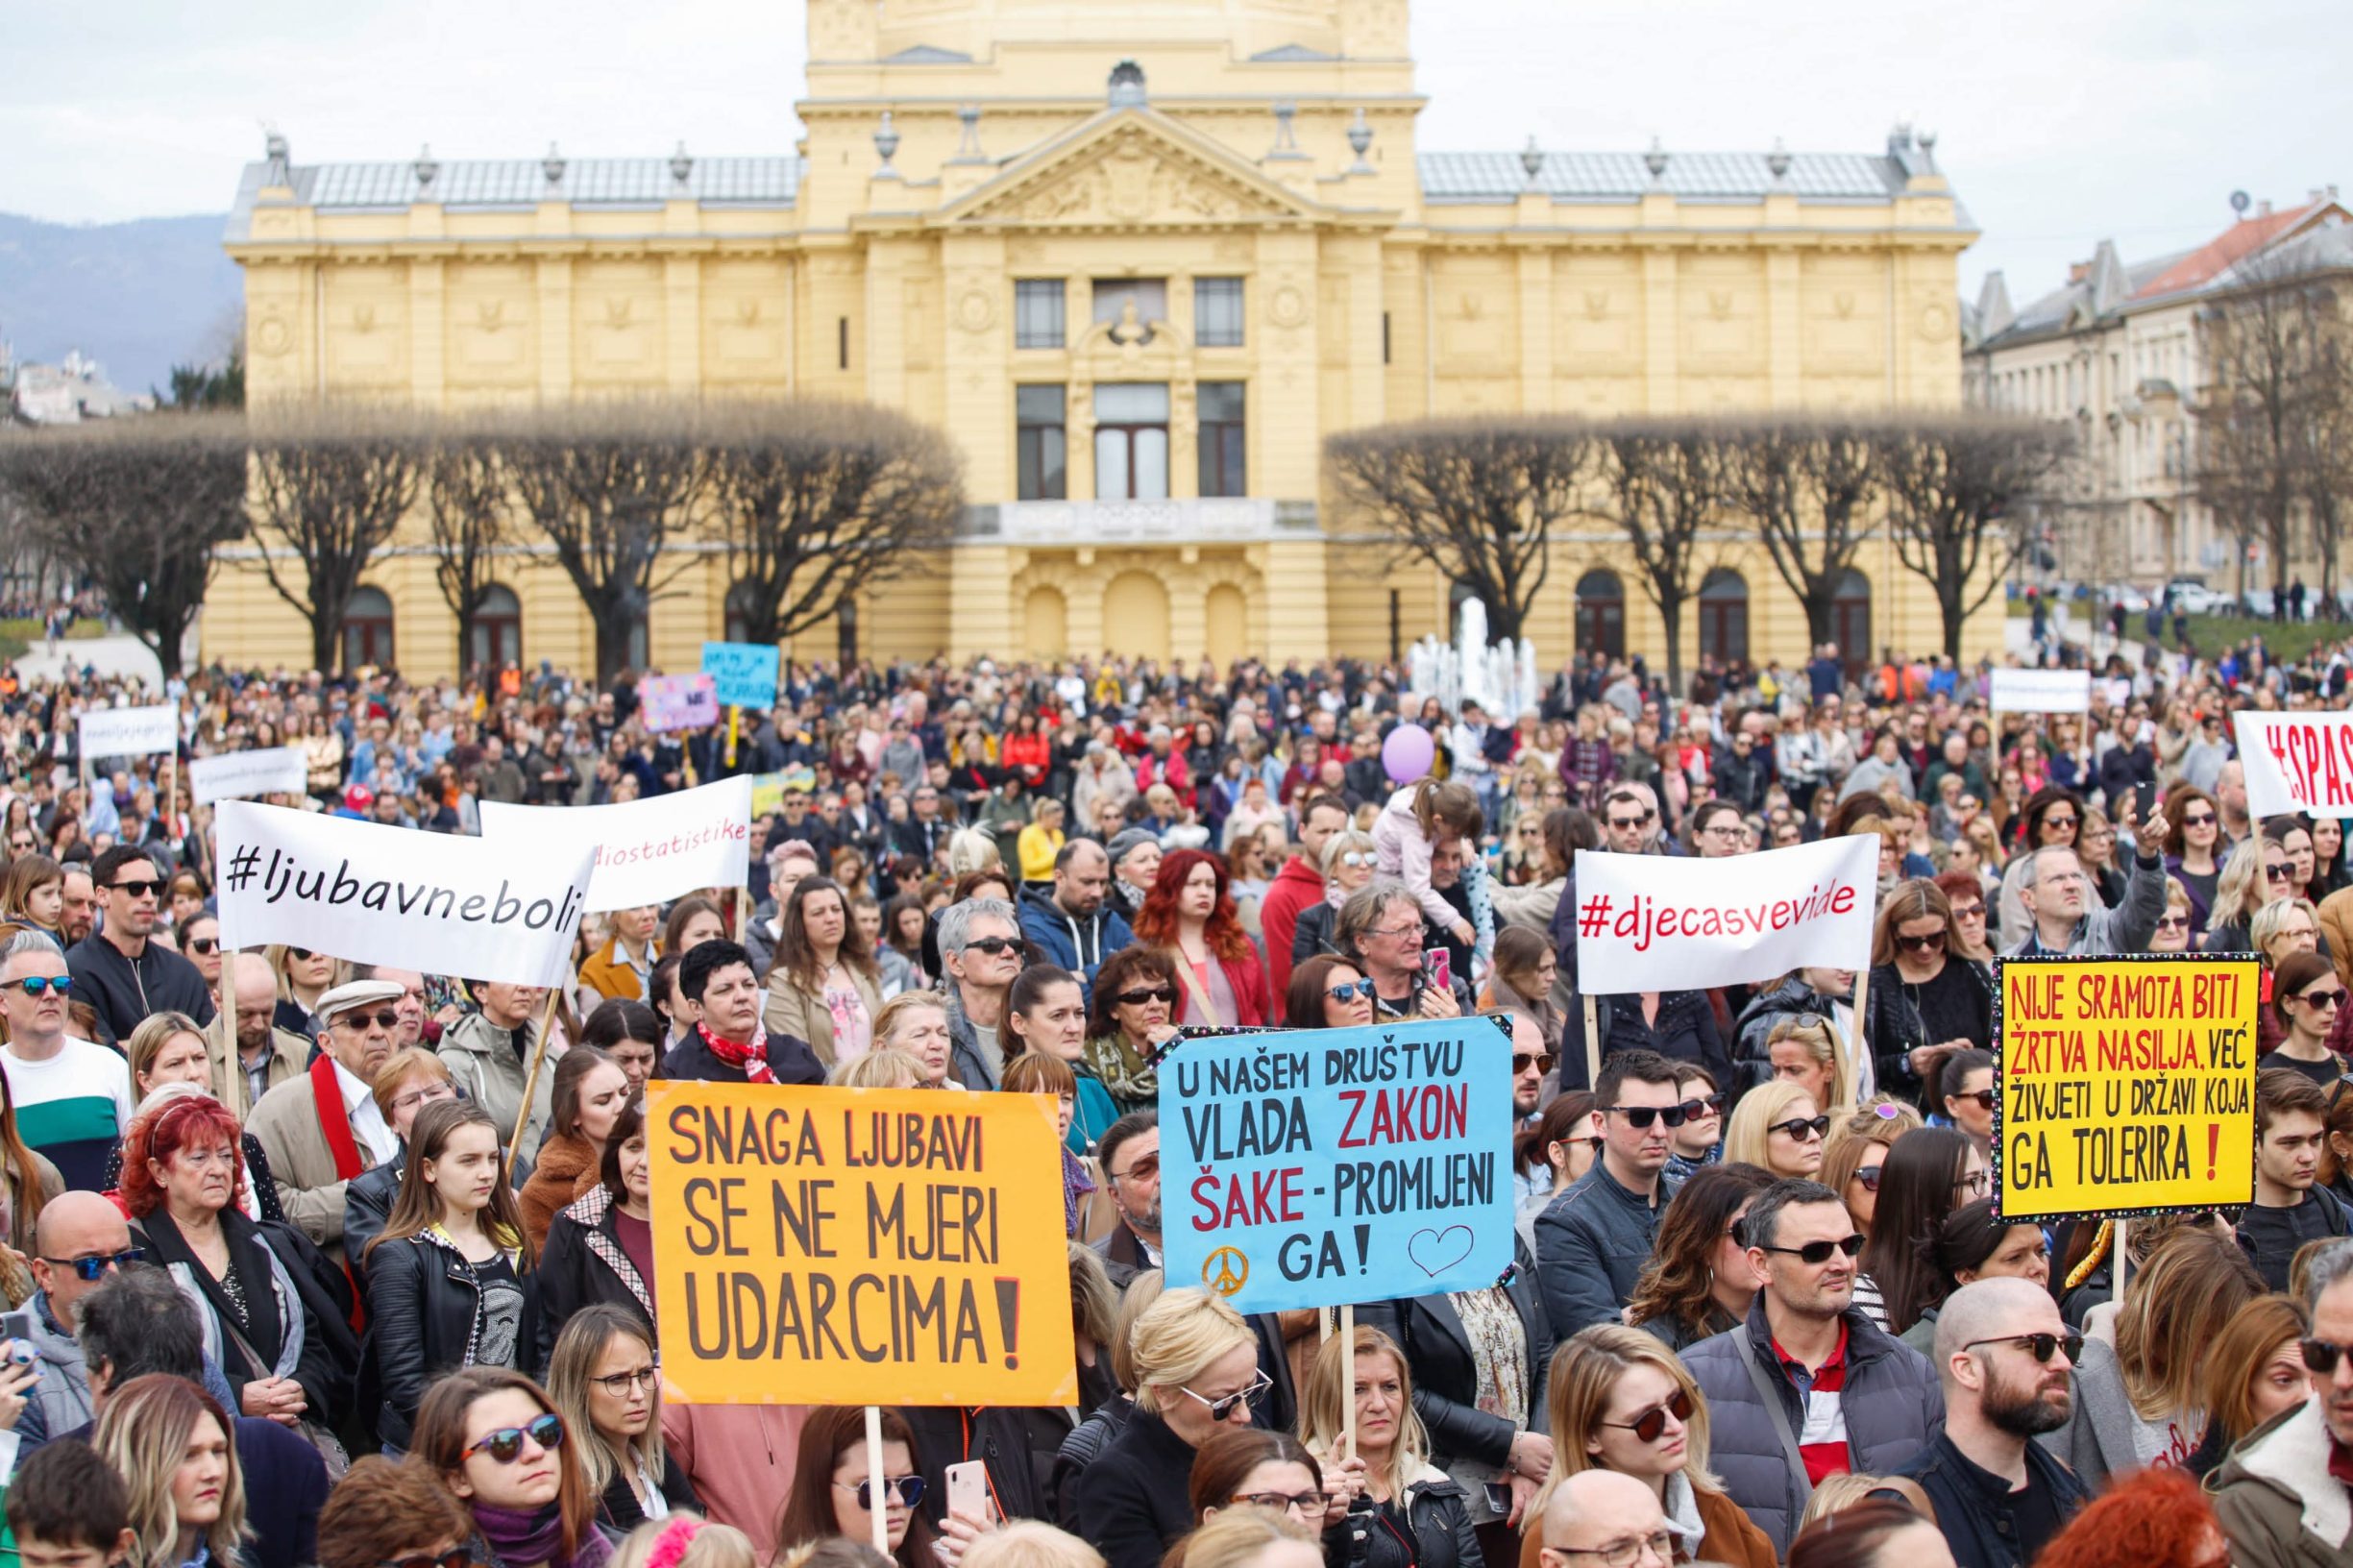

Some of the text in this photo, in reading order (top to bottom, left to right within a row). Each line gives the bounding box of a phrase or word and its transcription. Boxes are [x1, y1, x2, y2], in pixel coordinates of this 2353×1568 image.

[227, 845, 582, 934] #ljubavneboli
[1579, 877, 1855, 951] #djecasvevide
[2011, 974, 2239, 1020] NIJE SRAMOTA BITI
[1178, 1035, 1463, 1097] U NAŠEM DRUŠTVU
[2010, 1021, 2248, 1075] ŽRTVA NASILJA, VEĆ
[1182, 1082, 1468, 1163] VLADA ZAKON
[2010, 1072, 2248, 1122] ŽIVJETI U DRŽAVI KOJA
[669, 1105, 984, 1172] SNAGA LJUBAVI
[2011, 1131, 2053, 1190] GA
[2072, 1124, 2191, 1186] TOLERIRA
[684, 1177, 998, 1264] SE NE MJERI
[1190, 1164, 1305, 1232] ŠAKE
[1335, 1152, 1494, 1216] PROMIJENI
[684, 1272, 1020, 1371] UDARCIMA!
